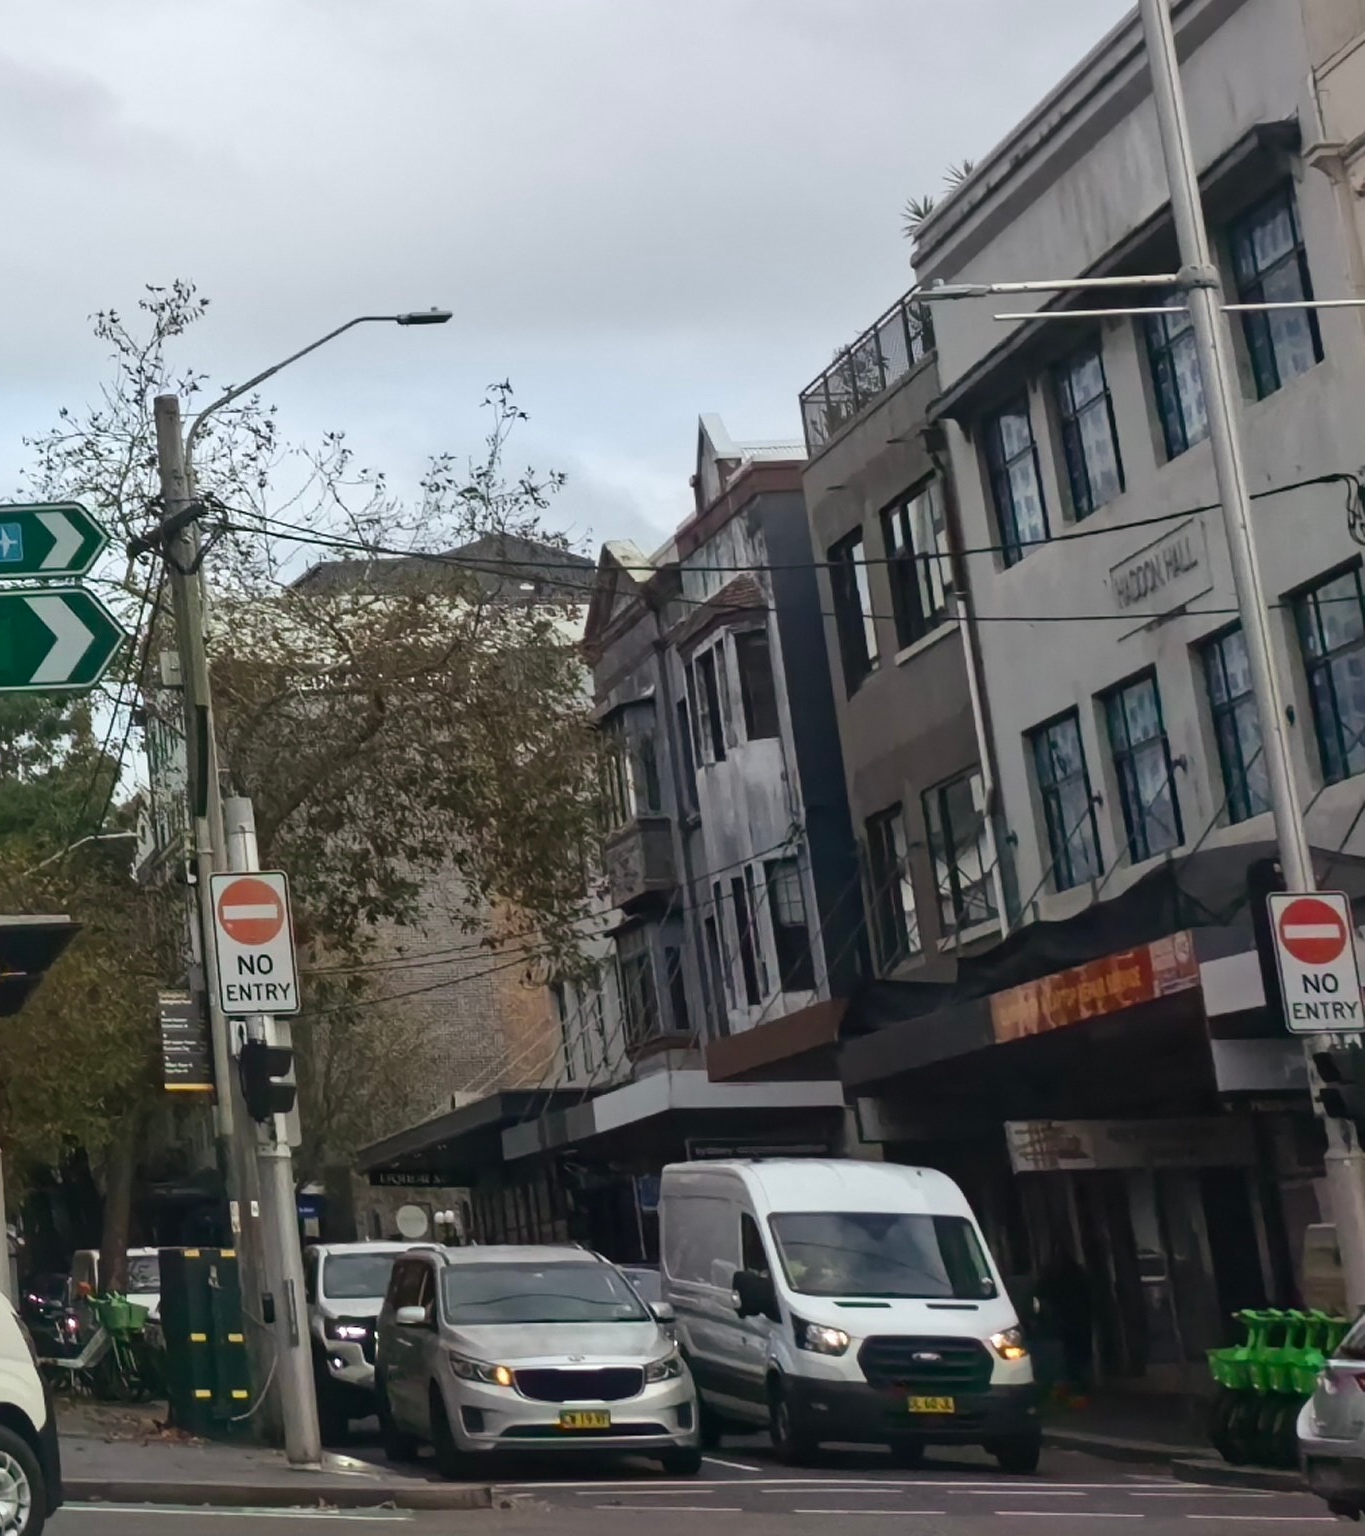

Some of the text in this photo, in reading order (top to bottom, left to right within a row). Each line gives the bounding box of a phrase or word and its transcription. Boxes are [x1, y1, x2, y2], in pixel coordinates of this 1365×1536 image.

[237, 954, 273, 975] NO
[226, 982, 290, 1001] ENTRY
[1302, 973, 1338, 994] NO
[1292, 1001, 1358, 1020] ENTRY
